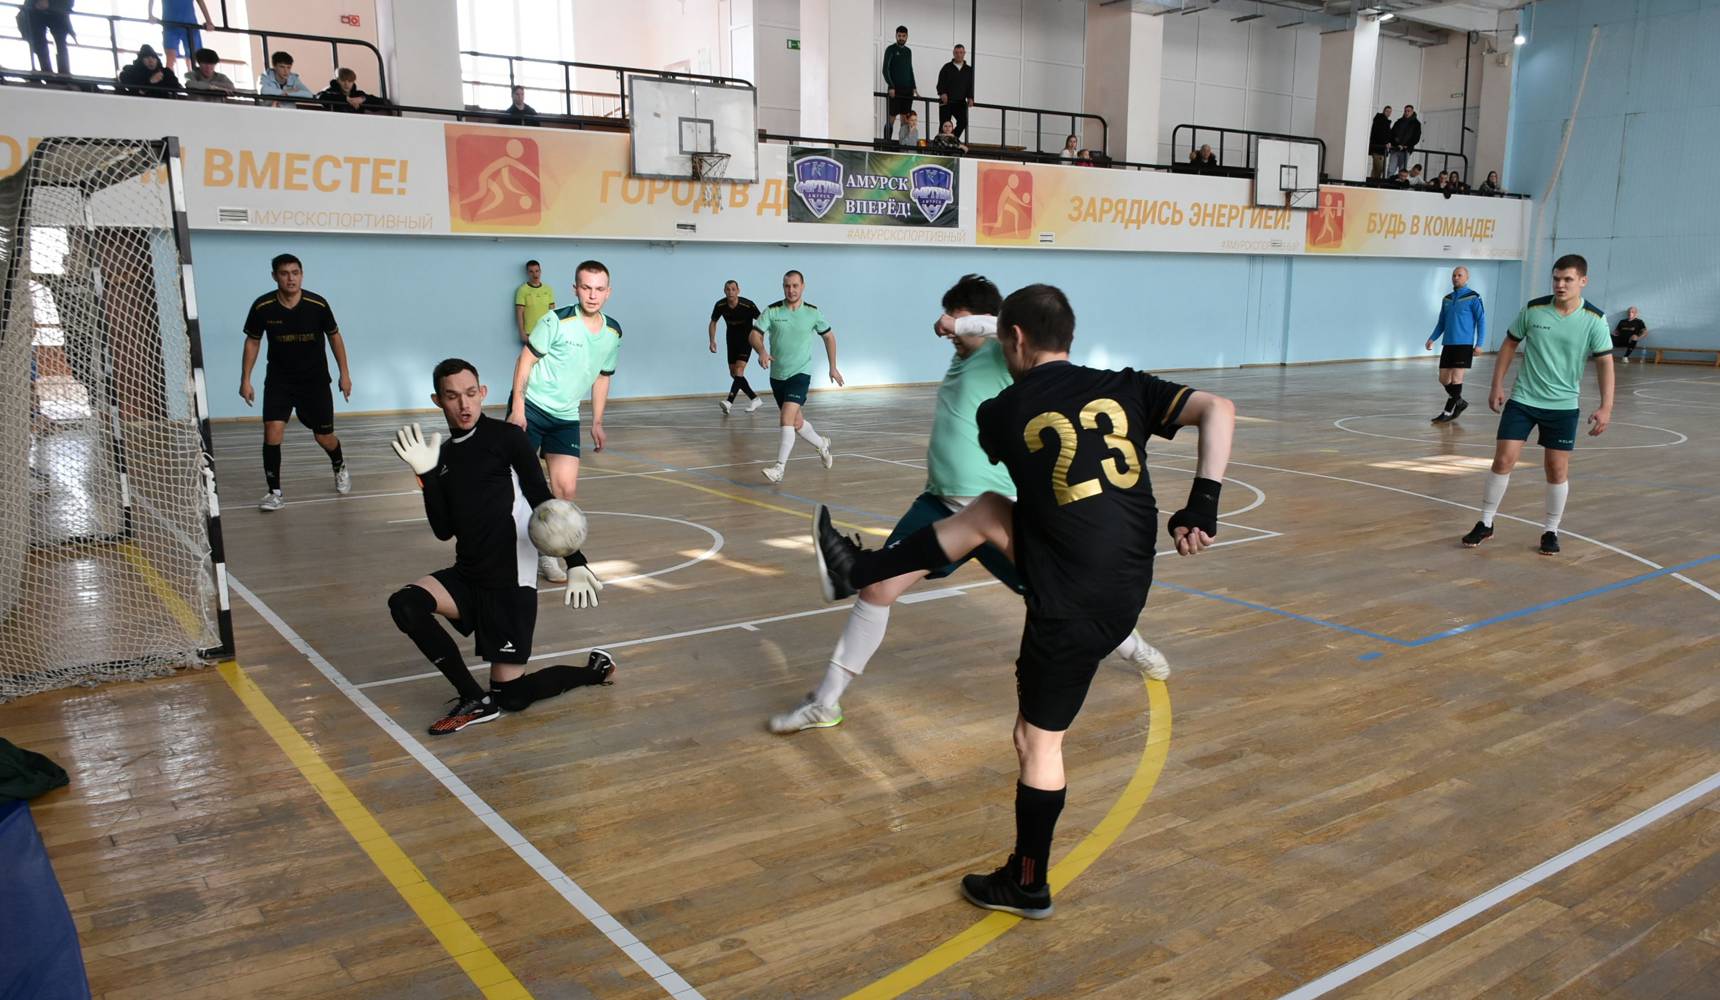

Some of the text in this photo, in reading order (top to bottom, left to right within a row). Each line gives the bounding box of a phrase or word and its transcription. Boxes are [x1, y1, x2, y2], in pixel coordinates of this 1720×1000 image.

[203, 147, 409, 196] ВМЕСТЕ!
[846, 174, 910, 191] АМУРСК
[729, 181, 750, 208] В
[756, 179, 789, 217] Д
[845, 198, 911, 218] ВПЕРЁД!
[1067, 195, 1184, 231] ЗАРЯДИСЬ
[251, 209, 433, 230] МУРСКСПОРТИВНЫЙ
[1366, 212, 1497, 242] БУДЬ В КОМАНДЕ!
[1023, 397, 1142, 506] 23
